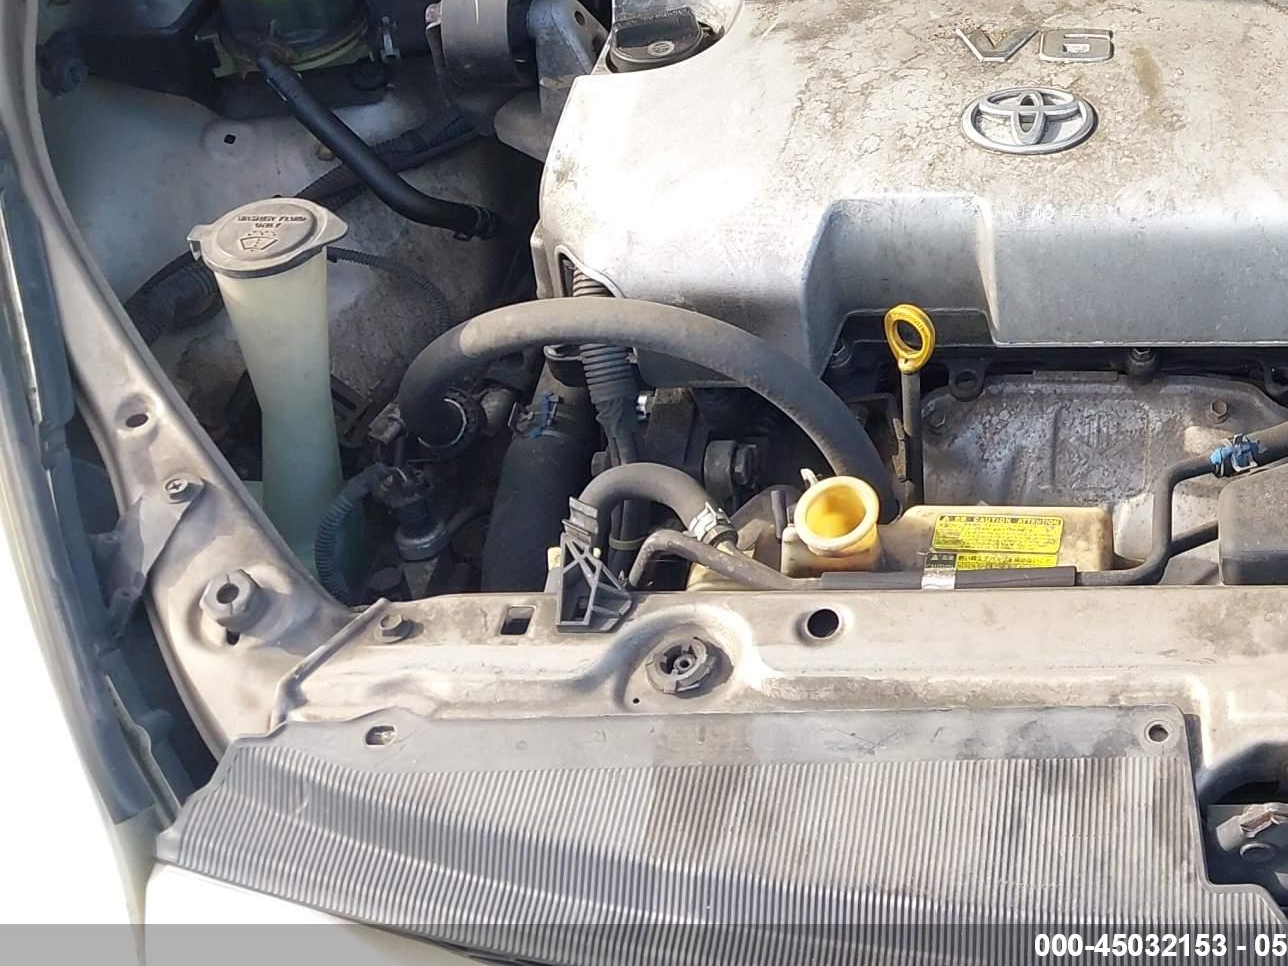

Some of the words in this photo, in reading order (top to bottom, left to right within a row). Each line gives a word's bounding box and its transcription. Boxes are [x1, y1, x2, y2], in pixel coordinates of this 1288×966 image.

[955, 28, 1115, 62] V6
[972, 516, 1012, 524] CAUTION
[1017, 518, 1060, 526] ATTENTION
